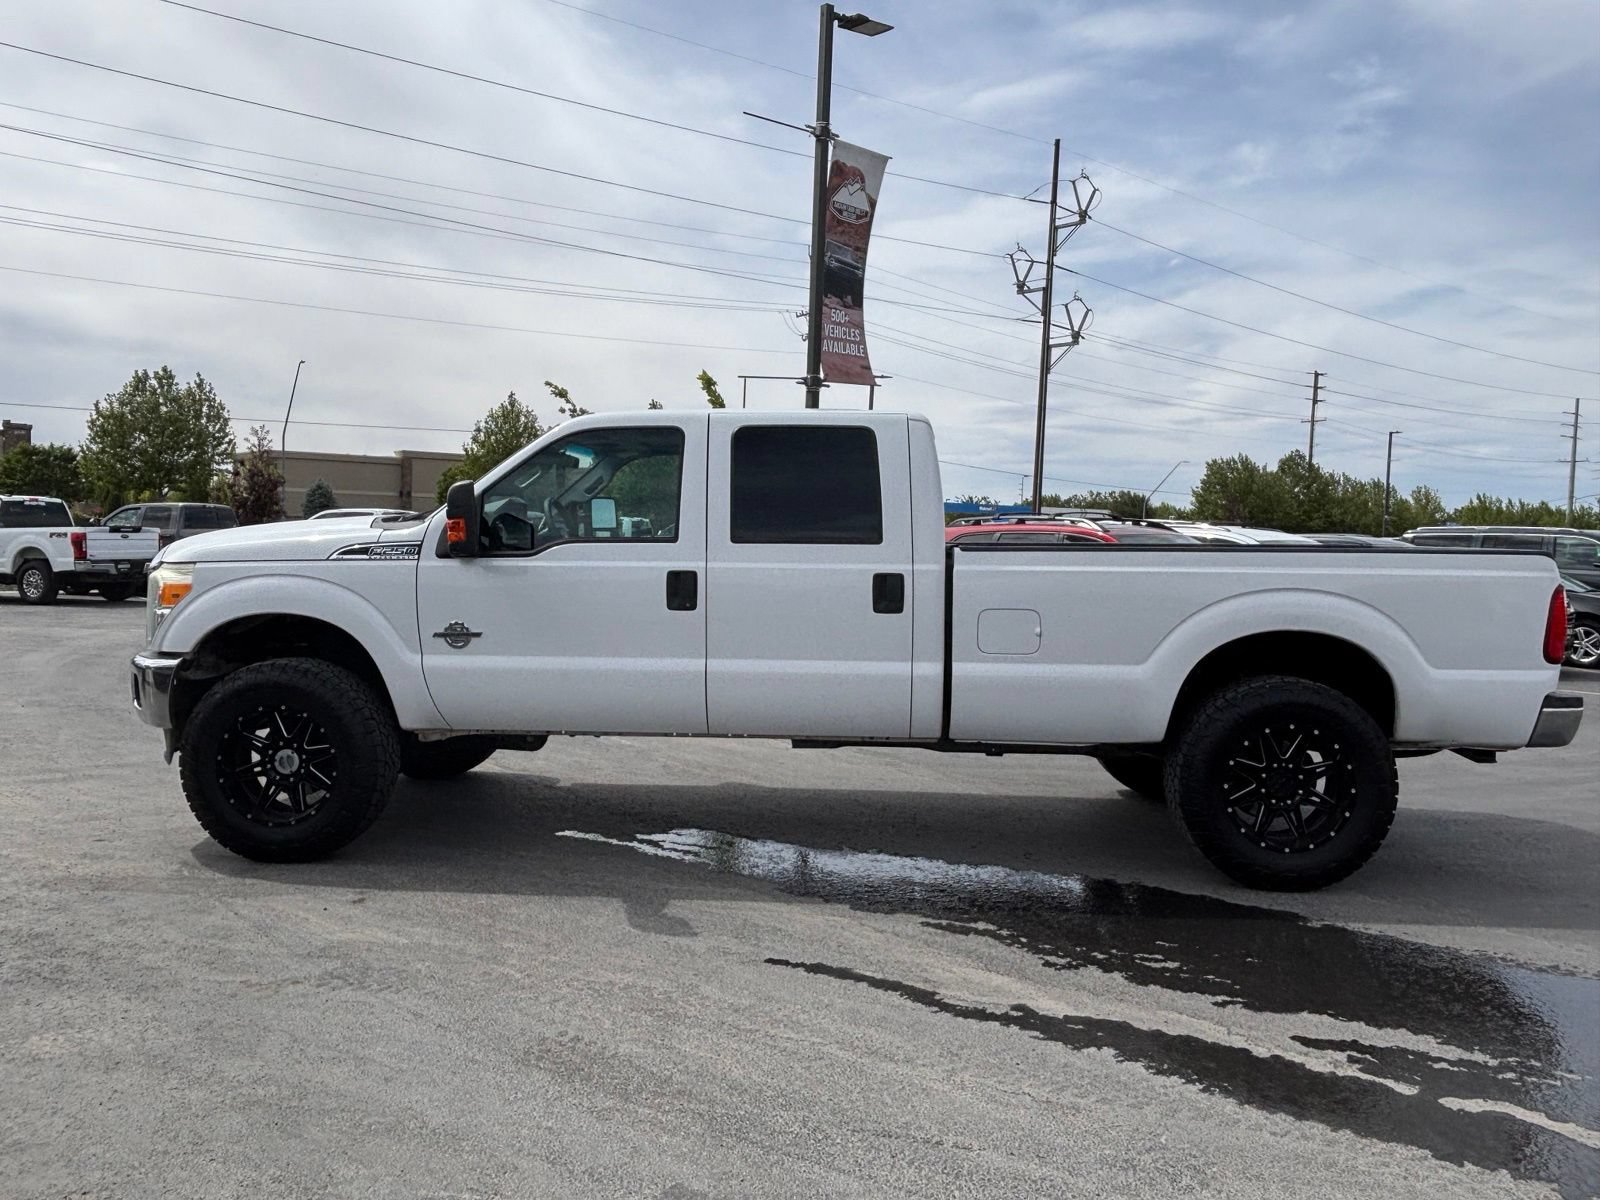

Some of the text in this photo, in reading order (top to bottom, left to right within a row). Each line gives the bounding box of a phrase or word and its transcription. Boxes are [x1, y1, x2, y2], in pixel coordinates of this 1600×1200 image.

[831, 308, 850, 323] 500+
[824, 323, 860, 341] VEHICLES
[823, 339, 865, 357] AVAILABLE
